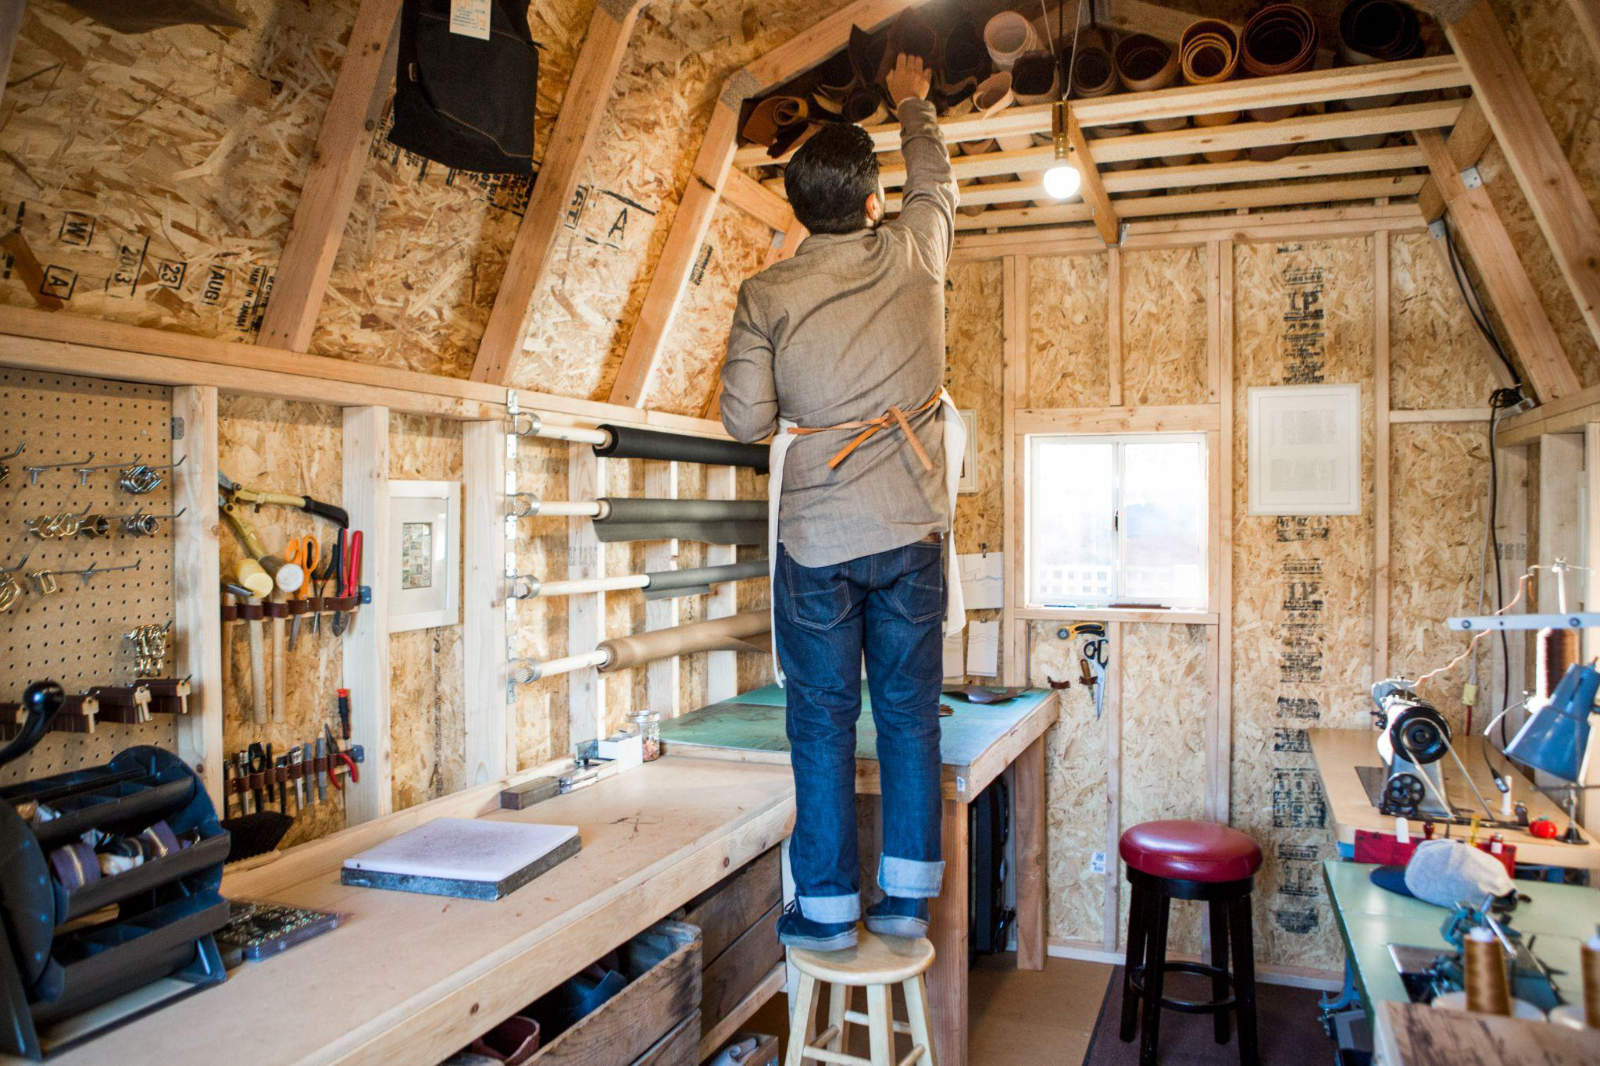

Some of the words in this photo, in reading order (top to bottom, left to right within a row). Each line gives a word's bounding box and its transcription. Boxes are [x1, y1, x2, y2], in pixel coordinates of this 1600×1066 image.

[607, 207, 628, 241] A
[159, 263, 182, 285] 23
[204, 270, 226, 302] AUG
